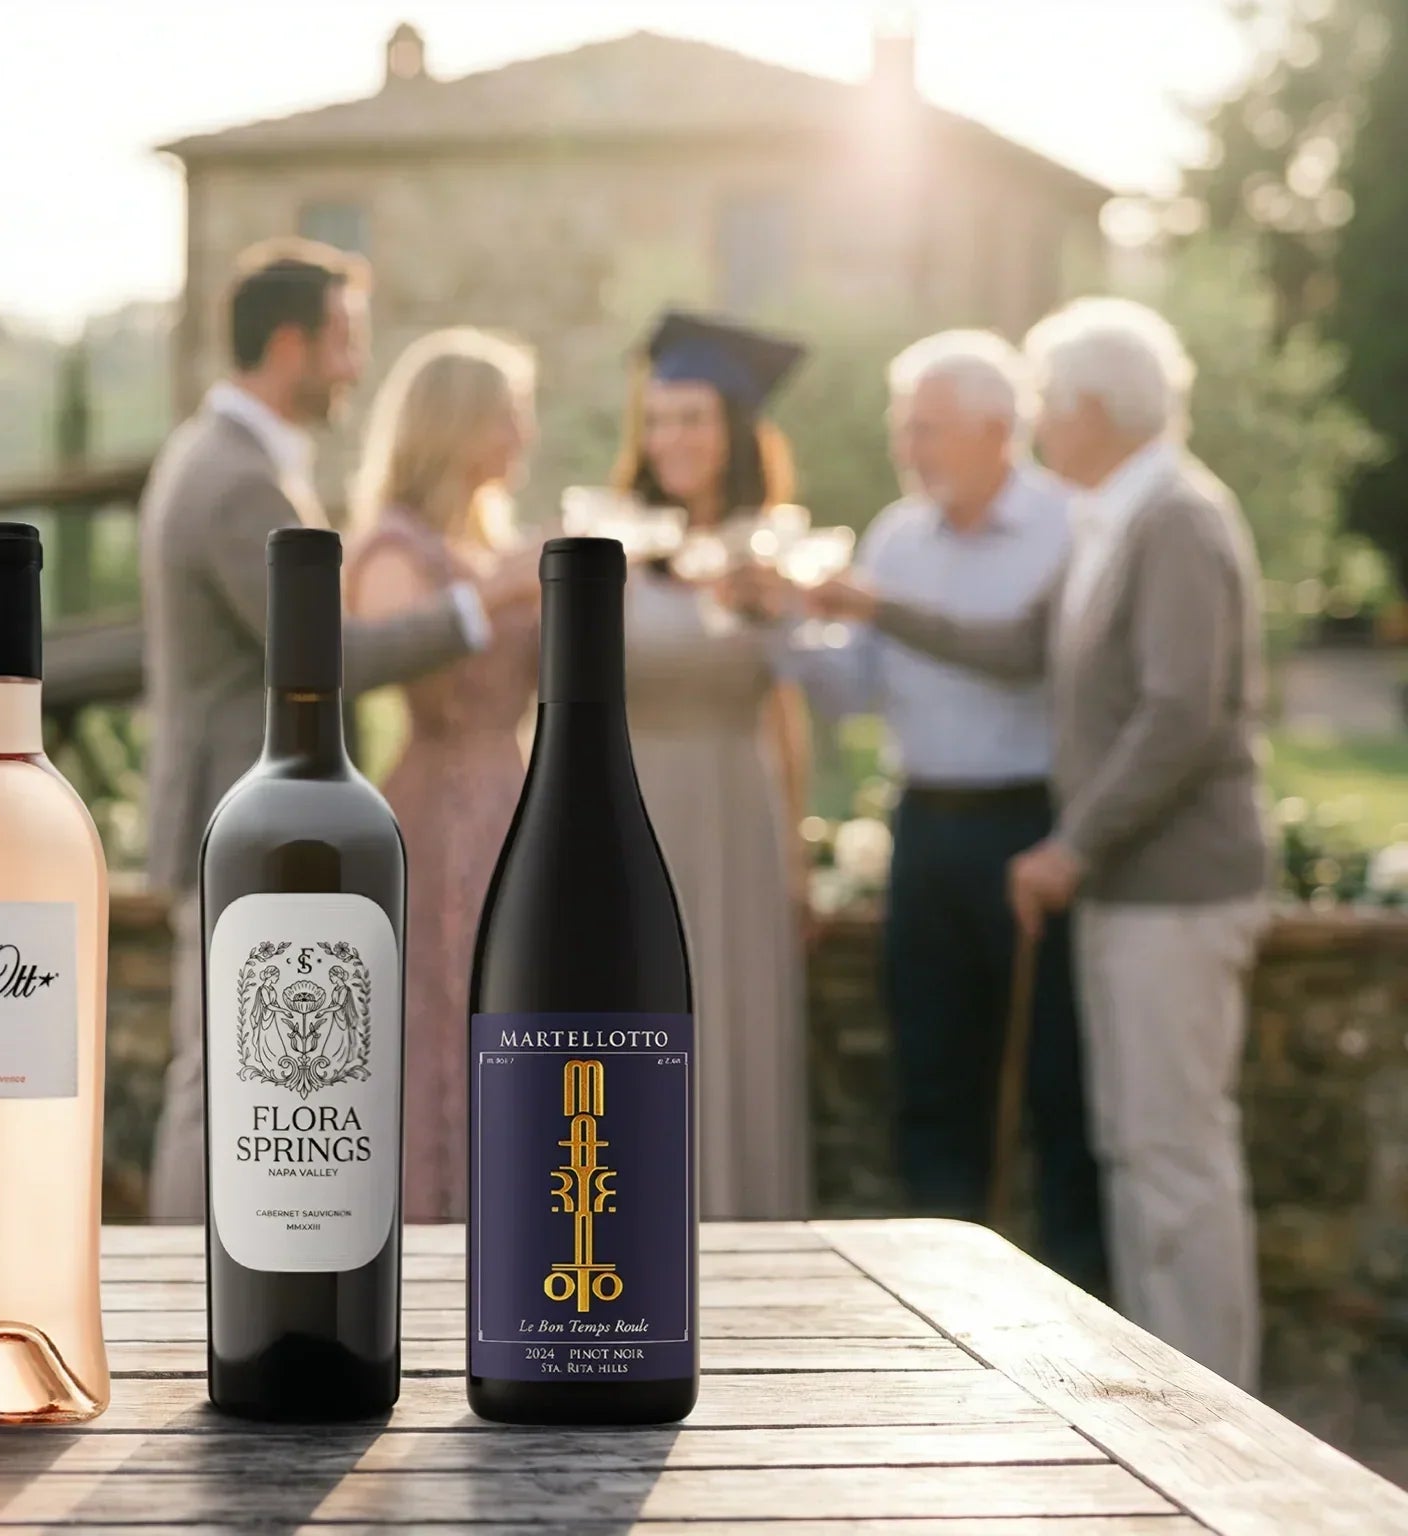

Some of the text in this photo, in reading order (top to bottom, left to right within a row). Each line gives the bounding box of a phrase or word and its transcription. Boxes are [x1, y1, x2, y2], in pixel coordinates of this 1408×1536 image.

[499, 1029, 669, 1048] MARTELLOTTO
[252, 1105, 362, 1132] FLORA
[236, 1135, 372, 1163] SPRINGS
[267, 1167, 339, 1177] NAPA VALLEY
[256, 1209, 353, 1218] CABERNET SAUVIGNON
[286, 1223, 321, 1231] MMXXIII
[519, 1319, 534, 1333] Le
[537, 1319, 565, 1333] Bon
[568, 1318, 611, 1337] Temps
[525, 1347, 645, 1360] 2024 PINOT NOIR
[567, 1362, 594, 1374] RITA
[598, 1363, 629, 1374] HILLS
